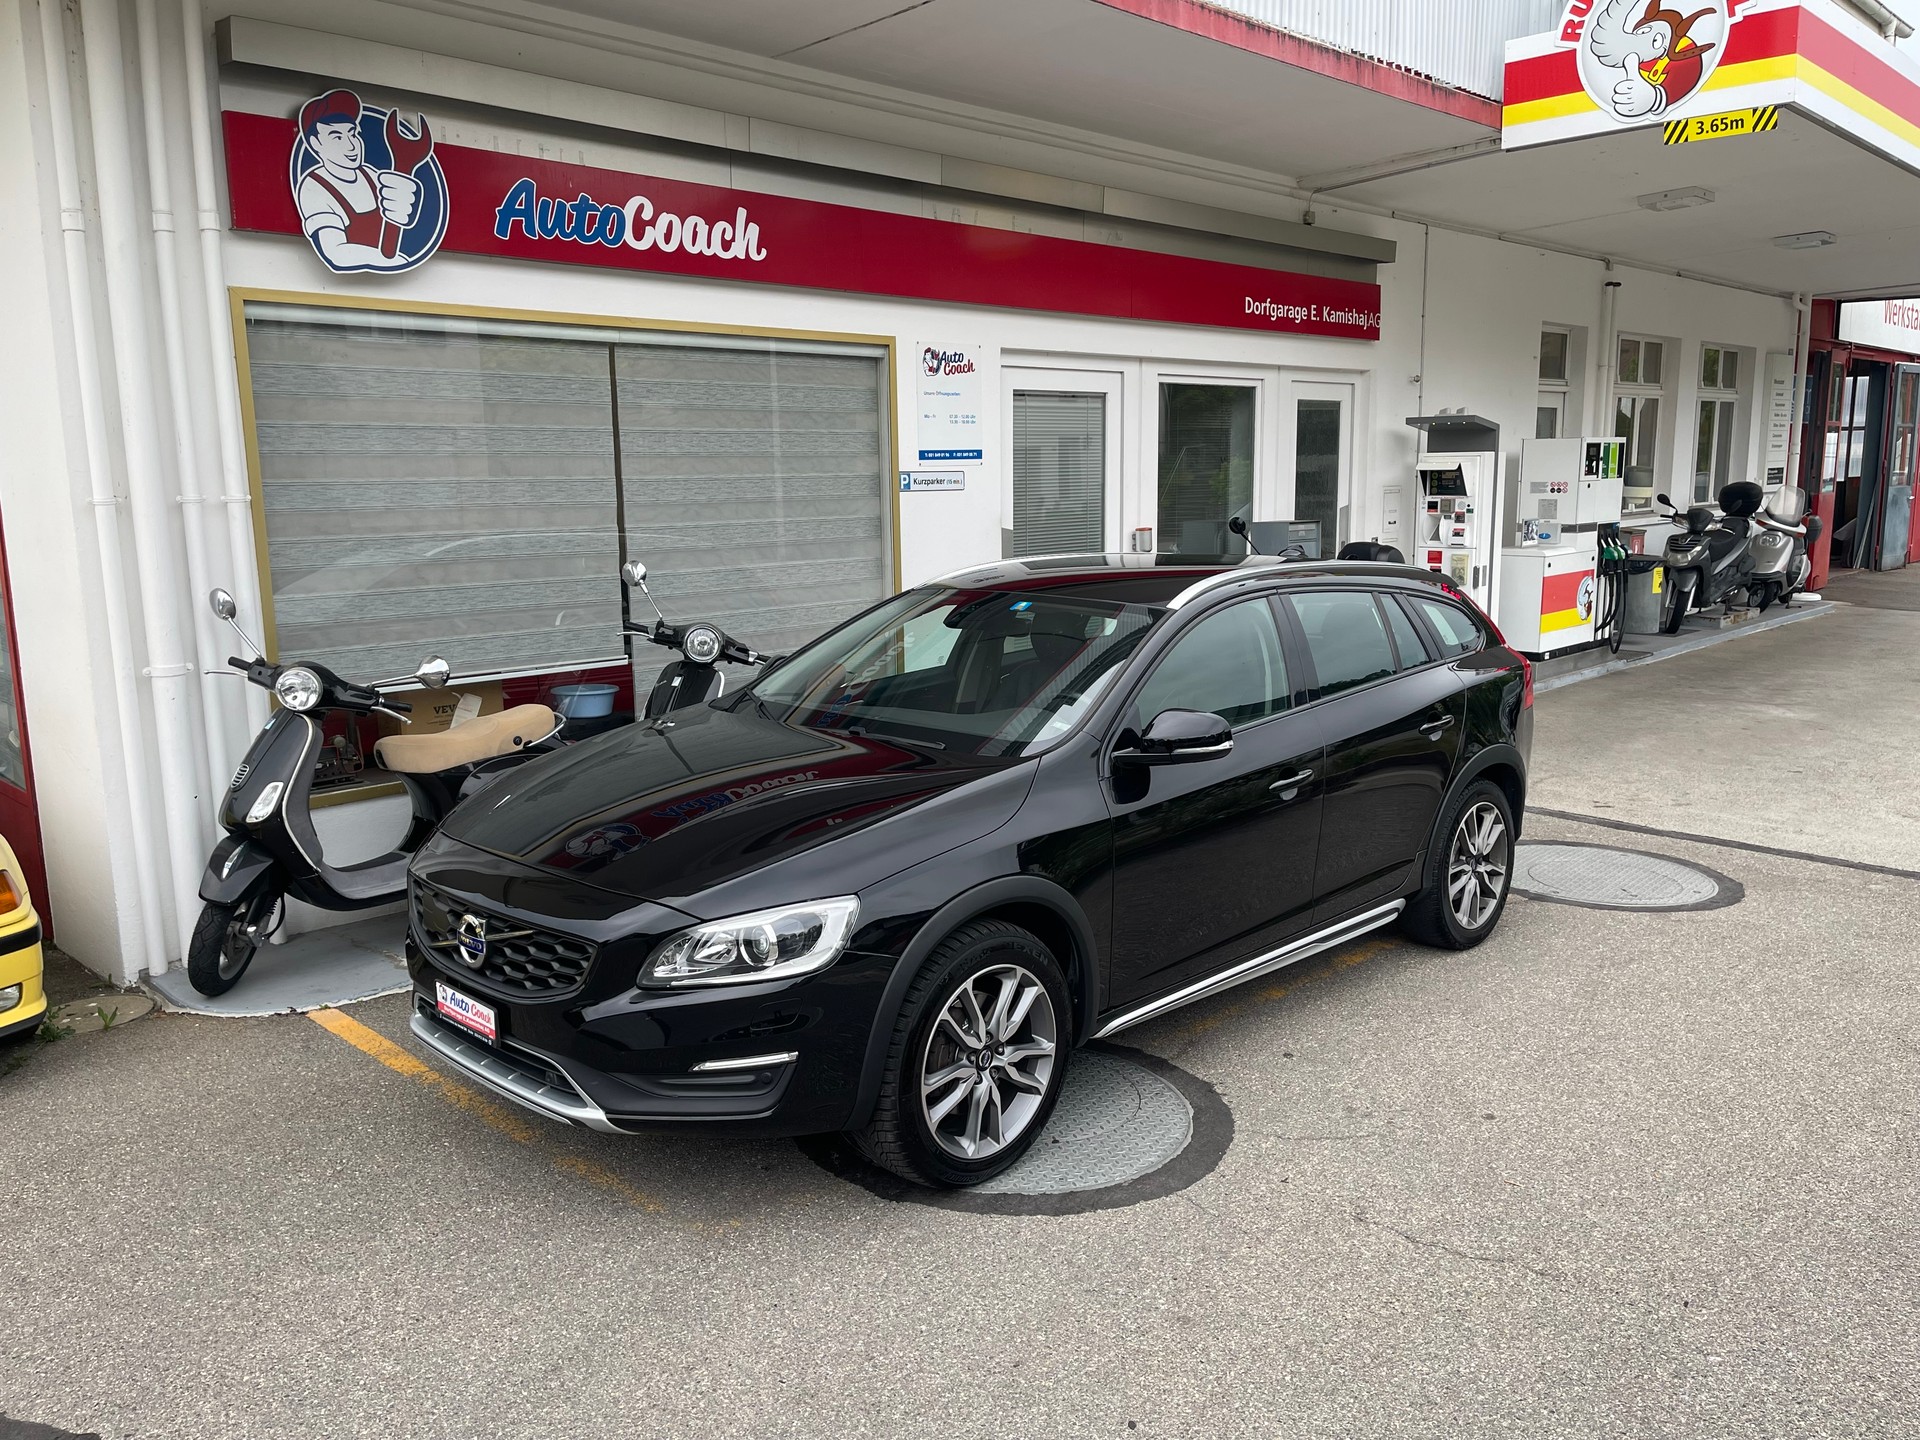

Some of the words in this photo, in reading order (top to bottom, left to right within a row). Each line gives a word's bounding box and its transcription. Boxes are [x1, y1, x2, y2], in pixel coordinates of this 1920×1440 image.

[1560, 0, 1594, 42] RU
[1695, 116, 1746, 136] 3.65m
[494, 177, 767, 261] AutoCoach
[1245, 296, 1308, 324] Dorfgarage
[1311, 304, 1320, 321] E.
[1323, 306, 1368, 330] Kamishaj
[1884, 299, 1920, 331] Werksta
[939, 350, 964, 366] Auto
[943, 358, 976, 376] Coach
[900, 474, 910, 489] P
[913, 477, 946, 487] Kurzparker
[433, 703, 458, 714] VEV
[459, 935, 483, 951] VOLVO
[450, 991, 470, 1014] Auto
[470, 1003, 493, 1026] Coach
